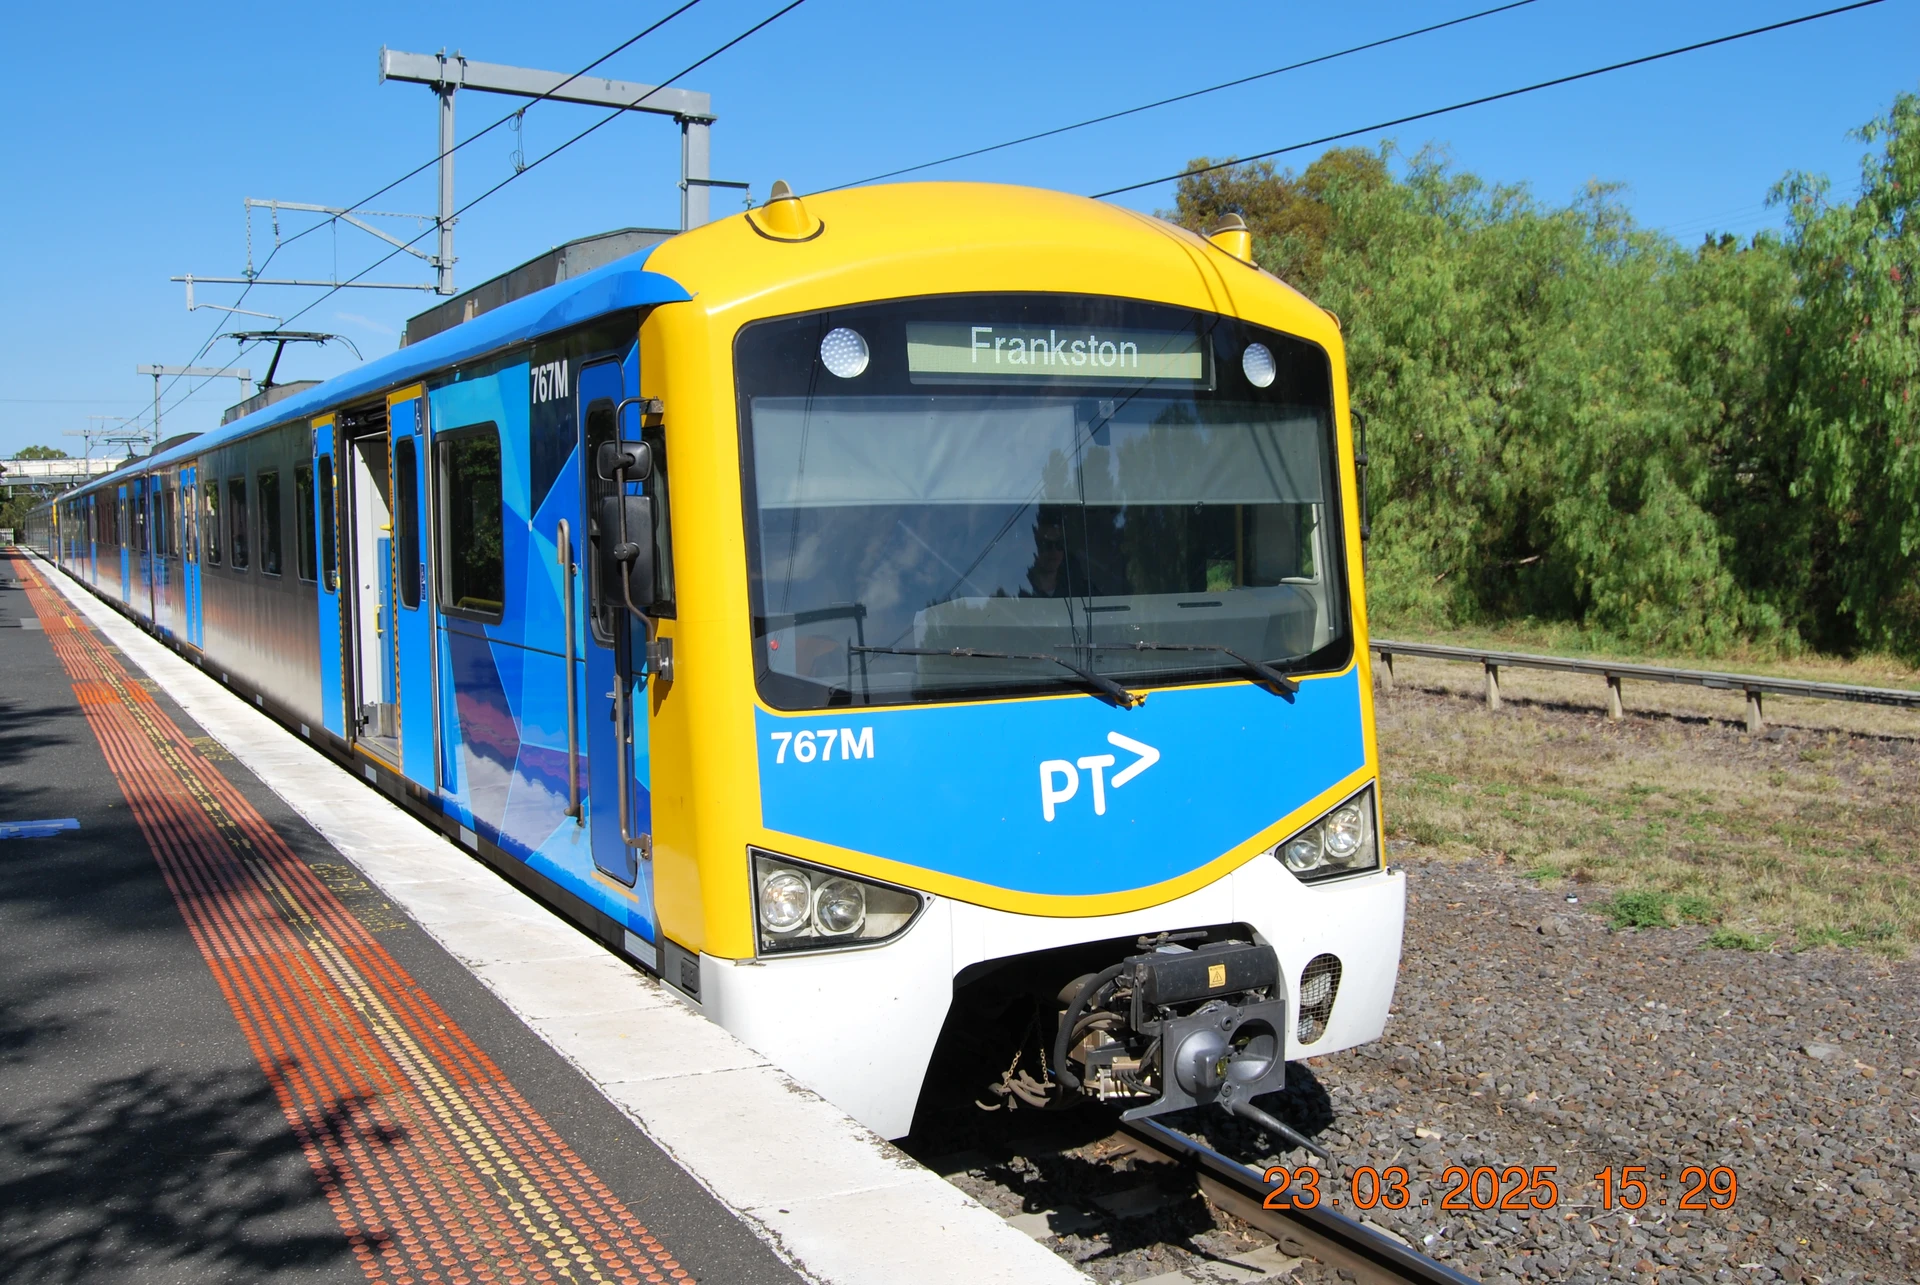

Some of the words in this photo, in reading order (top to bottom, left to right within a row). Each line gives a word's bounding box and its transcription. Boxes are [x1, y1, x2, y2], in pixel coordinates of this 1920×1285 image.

[971, 326, 1138, 368] Frankston
[531, 358, 569, 404] 767M
[770, 726, 875, 764] 767M
